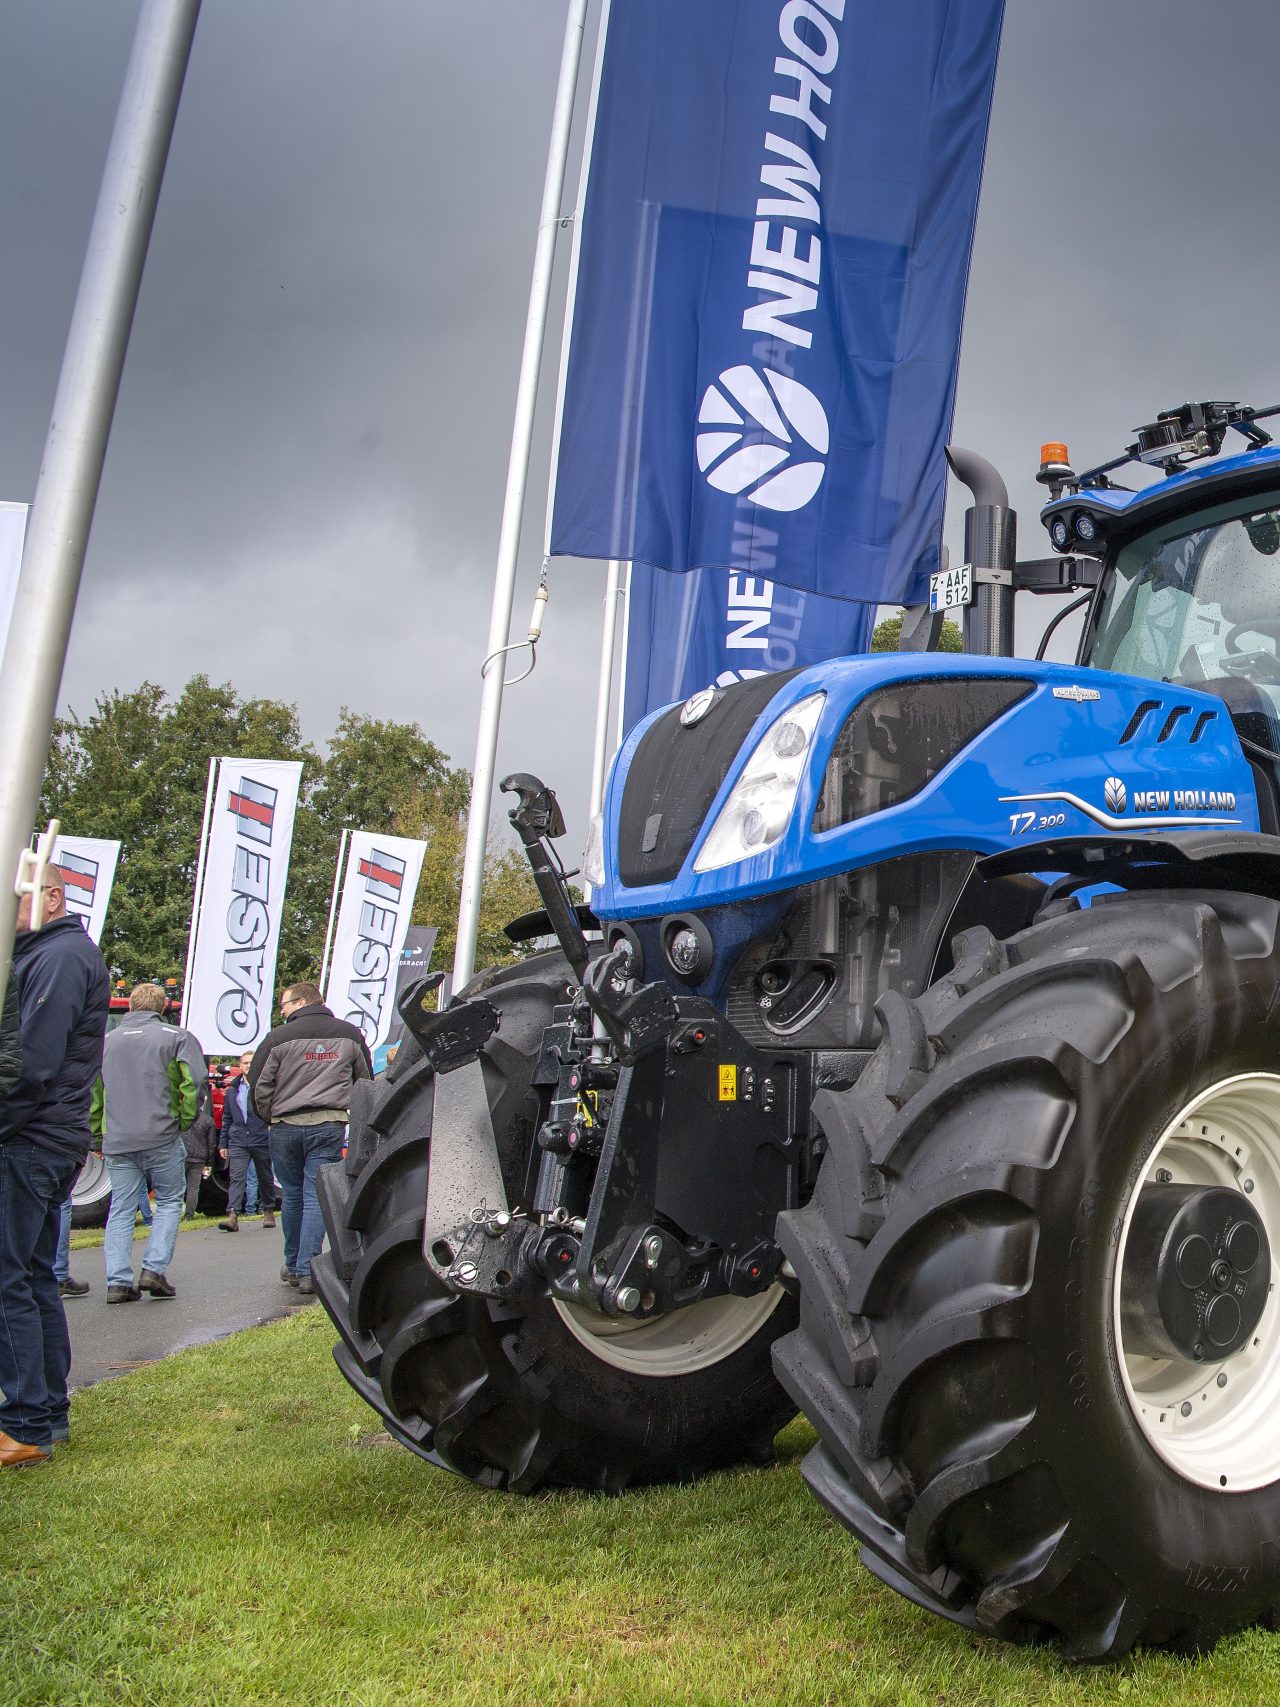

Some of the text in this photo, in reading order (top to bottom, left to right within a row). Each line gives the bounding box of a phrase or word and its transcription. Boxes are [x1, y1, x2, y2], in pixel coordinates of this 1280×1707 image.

[742, 132, 821, 349] NEW
[946, 586, 968, 605] 512
[1134, 790, 1236, 813] NEW HOLLAND
[1009, 811, 1065, 836] T7.300
[216, 844, 270, 1045] CASE
[317, 1052, 338, 1061] HEUS
